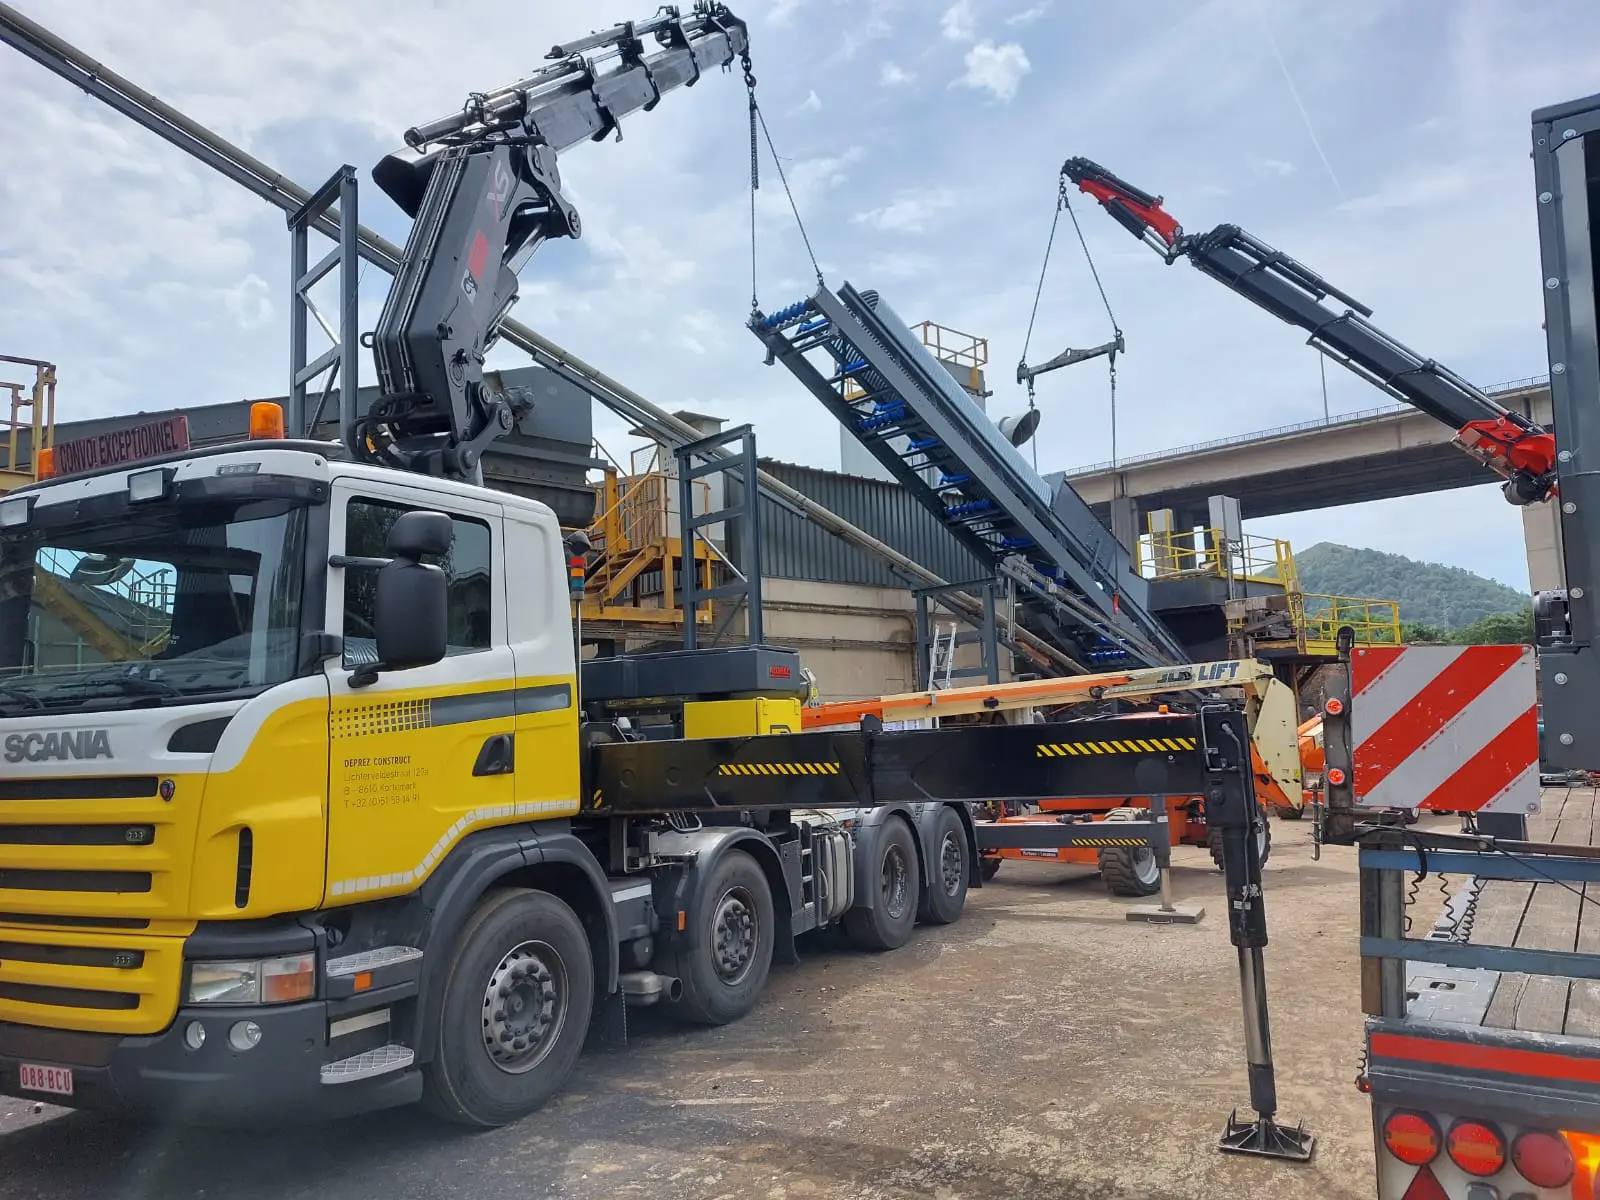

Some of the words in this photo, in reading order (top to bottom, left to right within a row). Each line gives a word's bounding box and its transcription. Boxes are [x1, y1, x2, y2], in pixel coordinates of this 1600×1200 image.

[60, 436, 98, 473] CONVOI
[99, 420, 179, 465] EXCEPTIONNEL
[1197, 661, 1240, 681] LIFT
[4, 729, 114, 763] SCANIA
[344, 758, 370, 768] DEPREZ
[373, 755, 411, 766] CONSTRUCT
[343, 786, 350, 796] B
[343, 799, 349, 809] T
